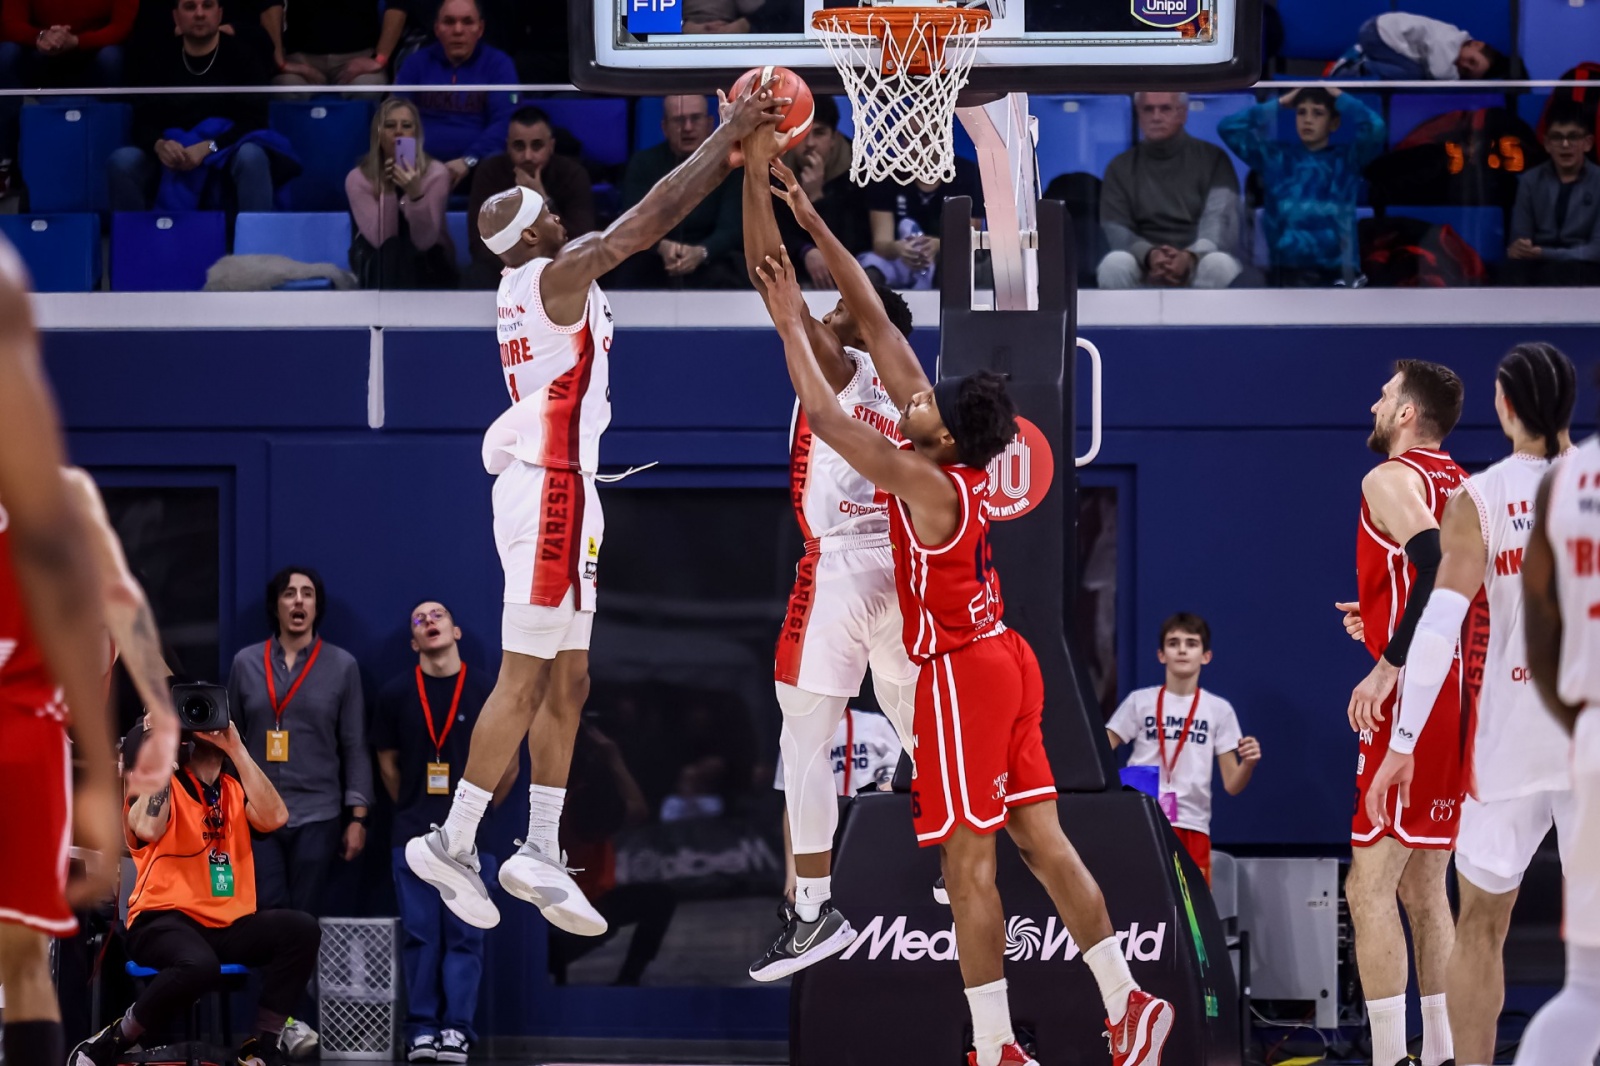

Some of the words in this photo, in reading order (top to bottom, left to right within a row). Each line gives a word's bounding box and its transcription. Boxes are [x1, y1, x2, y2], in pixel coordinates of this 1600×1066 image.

[1146, 0, 1187, 15] Unipol
[541, 477, 570, 561] VARESE
[1001, 497, 1030, 518] MILANO
[785, 562, 812, 644] VARESE
[1040, 916, 1167, 962] Wrld
